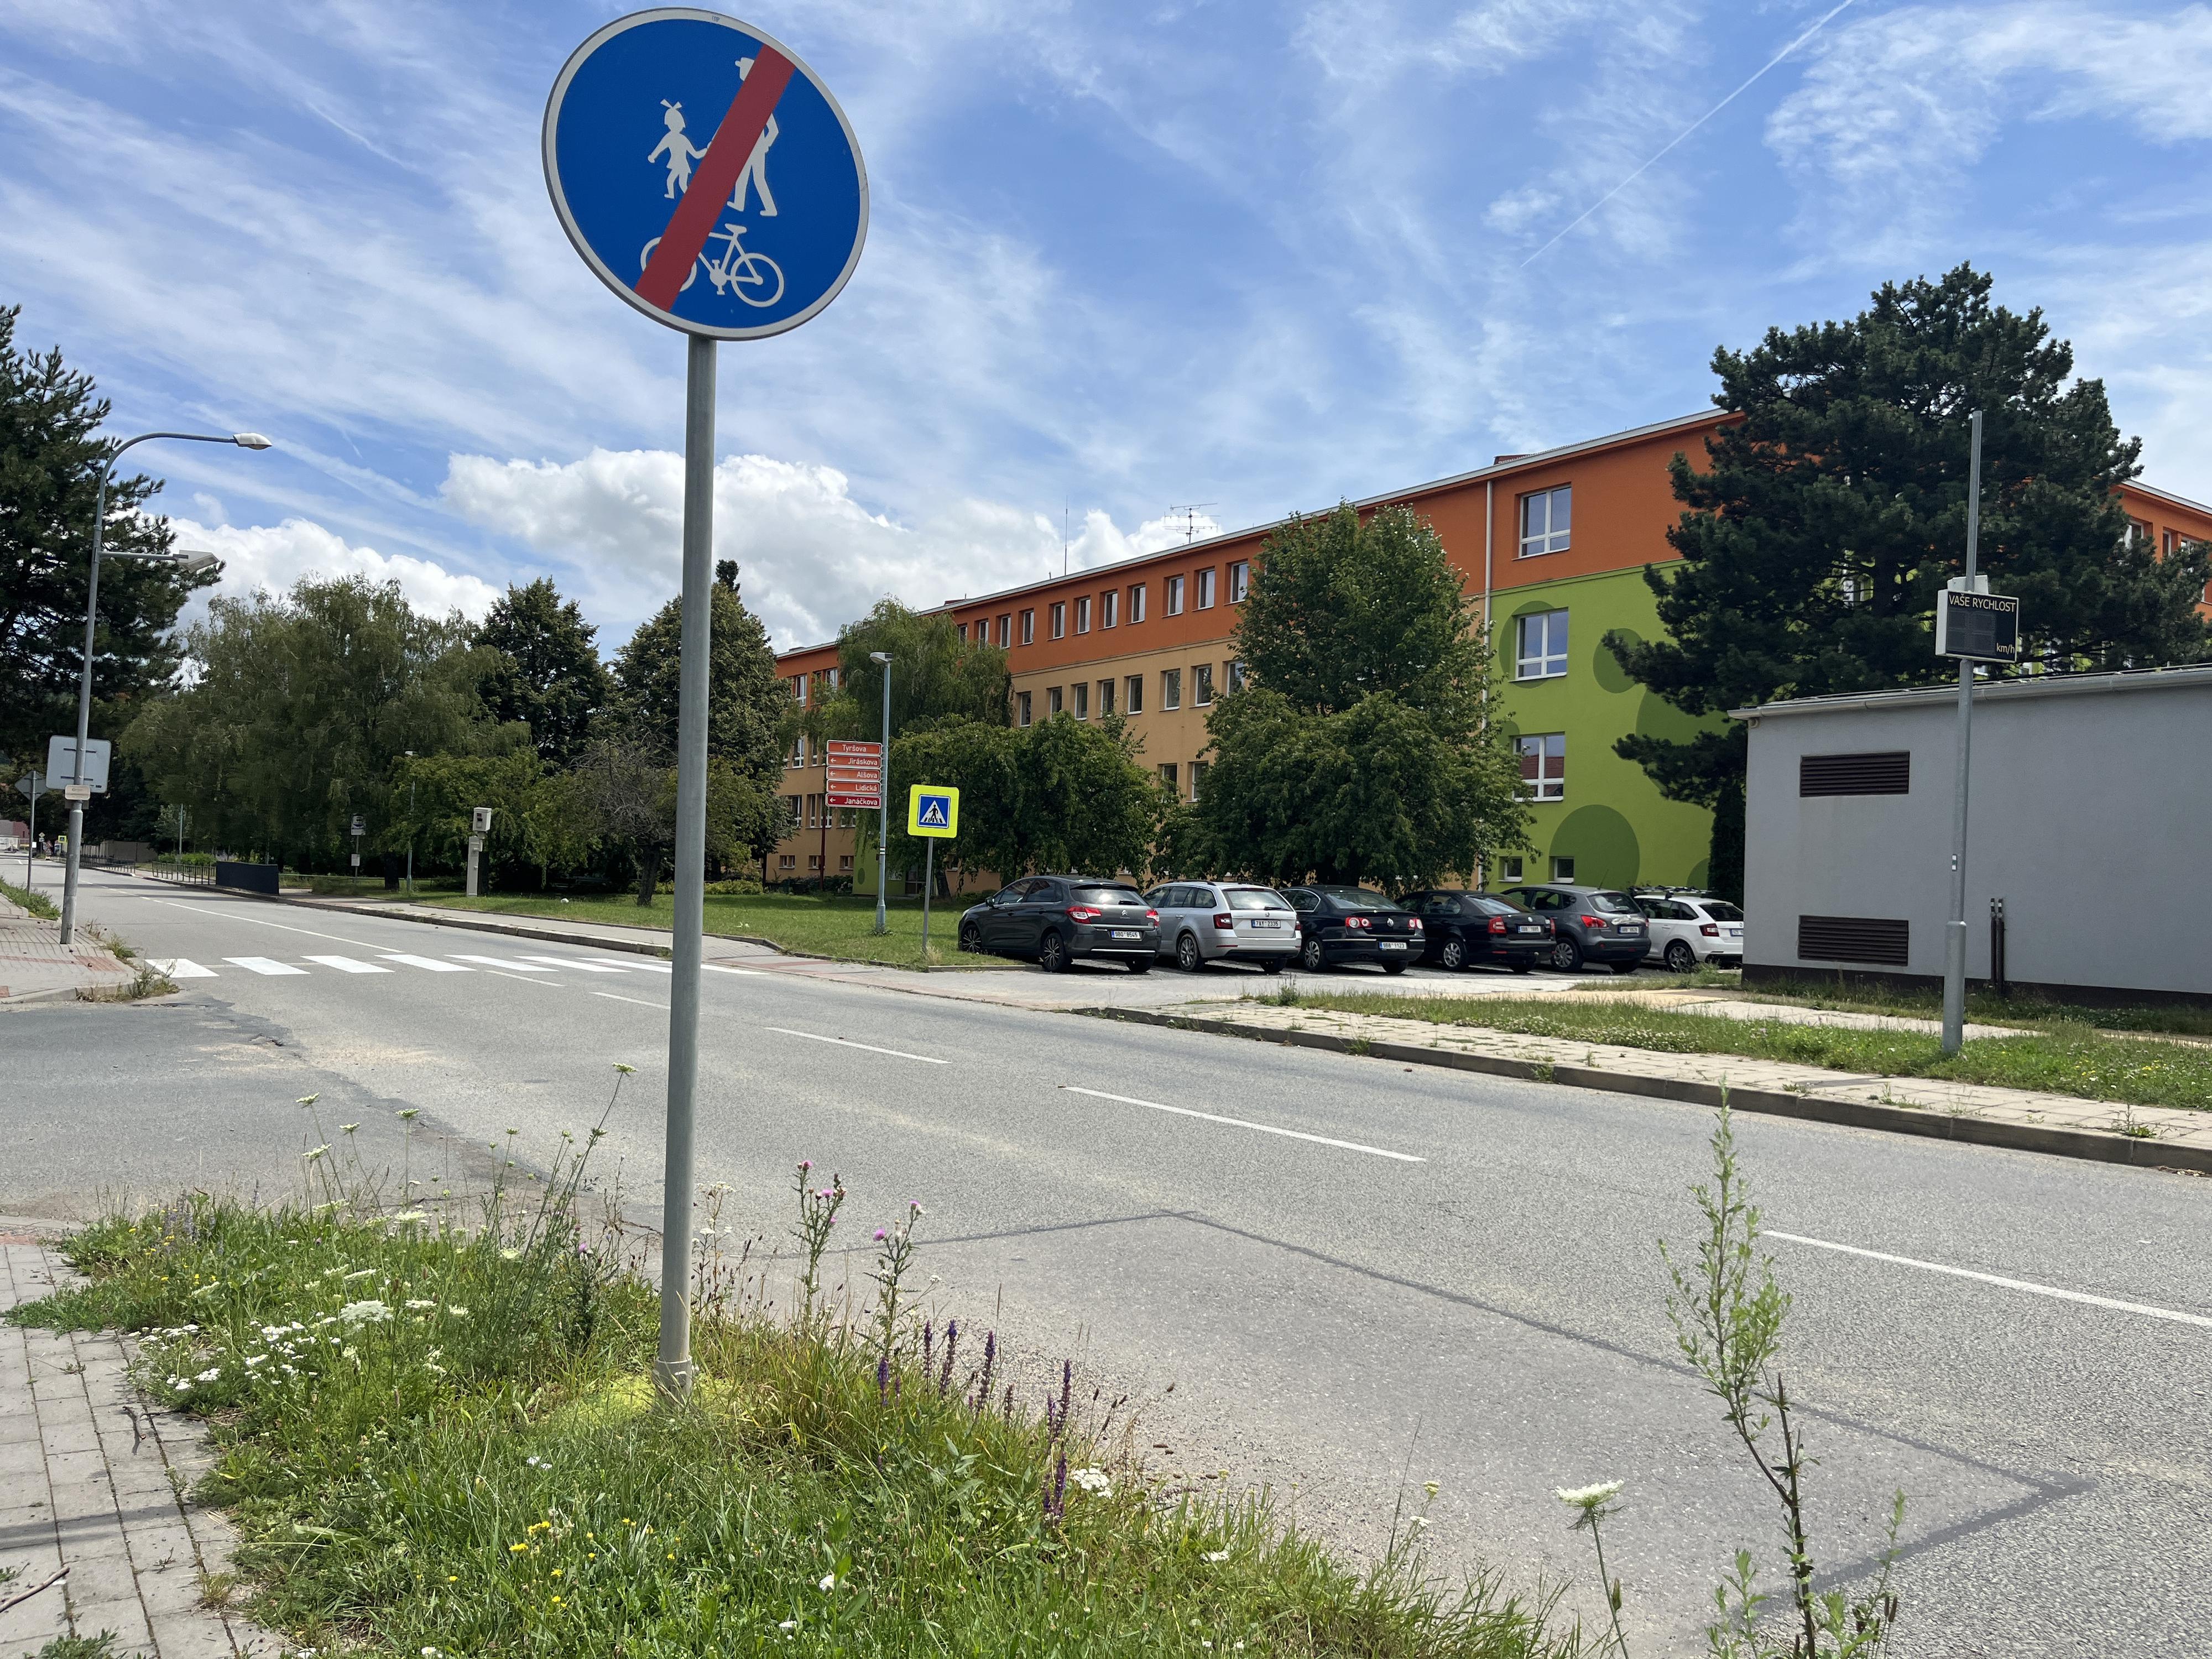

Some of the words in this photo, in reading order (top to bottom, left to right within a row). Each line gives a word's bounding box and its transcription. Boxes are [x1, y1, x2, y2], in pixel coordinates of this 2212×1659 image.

[1949, 594, 1970, 607] VAŠE
[1973, 598, 2016, 612] RYCHLOST
[1996, 643, 2015, 654] km/h
